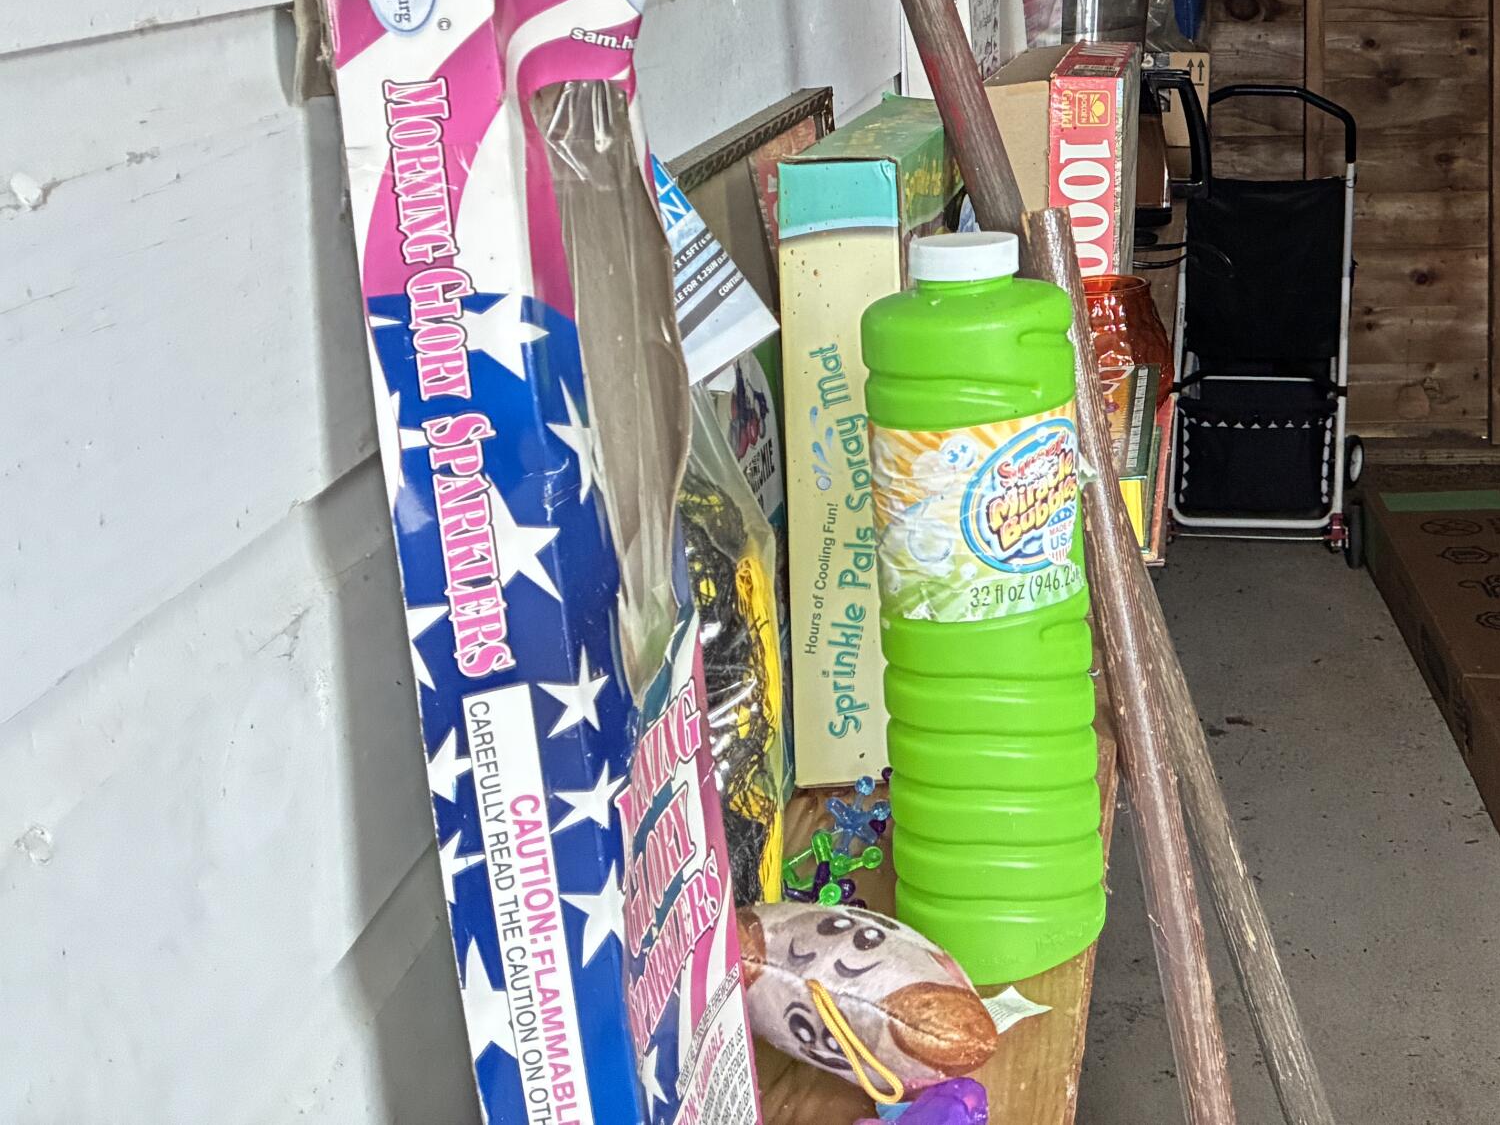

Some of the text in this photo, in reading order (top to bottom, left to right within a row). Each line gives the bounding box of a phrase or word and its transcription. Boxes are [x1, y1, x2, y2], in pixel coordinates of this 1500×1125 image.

[1061, 89, 1073, 129] Guild
[684, 279, 699, 298] FOR
[383, 77, 516, 678] MORNING GLORY SPARKLERS
[987, 450, 1075, 532] Miracle
[804, 502, 839, 655] Hours of Cooling Fun!
[808, 343, 876, 740] Sprinkle Pals Spray Mat
[969, 585, 991, 608] 32
[995, 584, 1004, 604] fl
[1008, 582, 1025, 603] oz
[468, 701, 507, 824] CAREFULLY
[488, 830, 516, 892] READ
[509, 794, 559, 945] CAUTION:
[498, 894, 524, 942] THE
[506, 946, 539, 1044] CAUTION
[522, 1049, 546, 1082] ON
